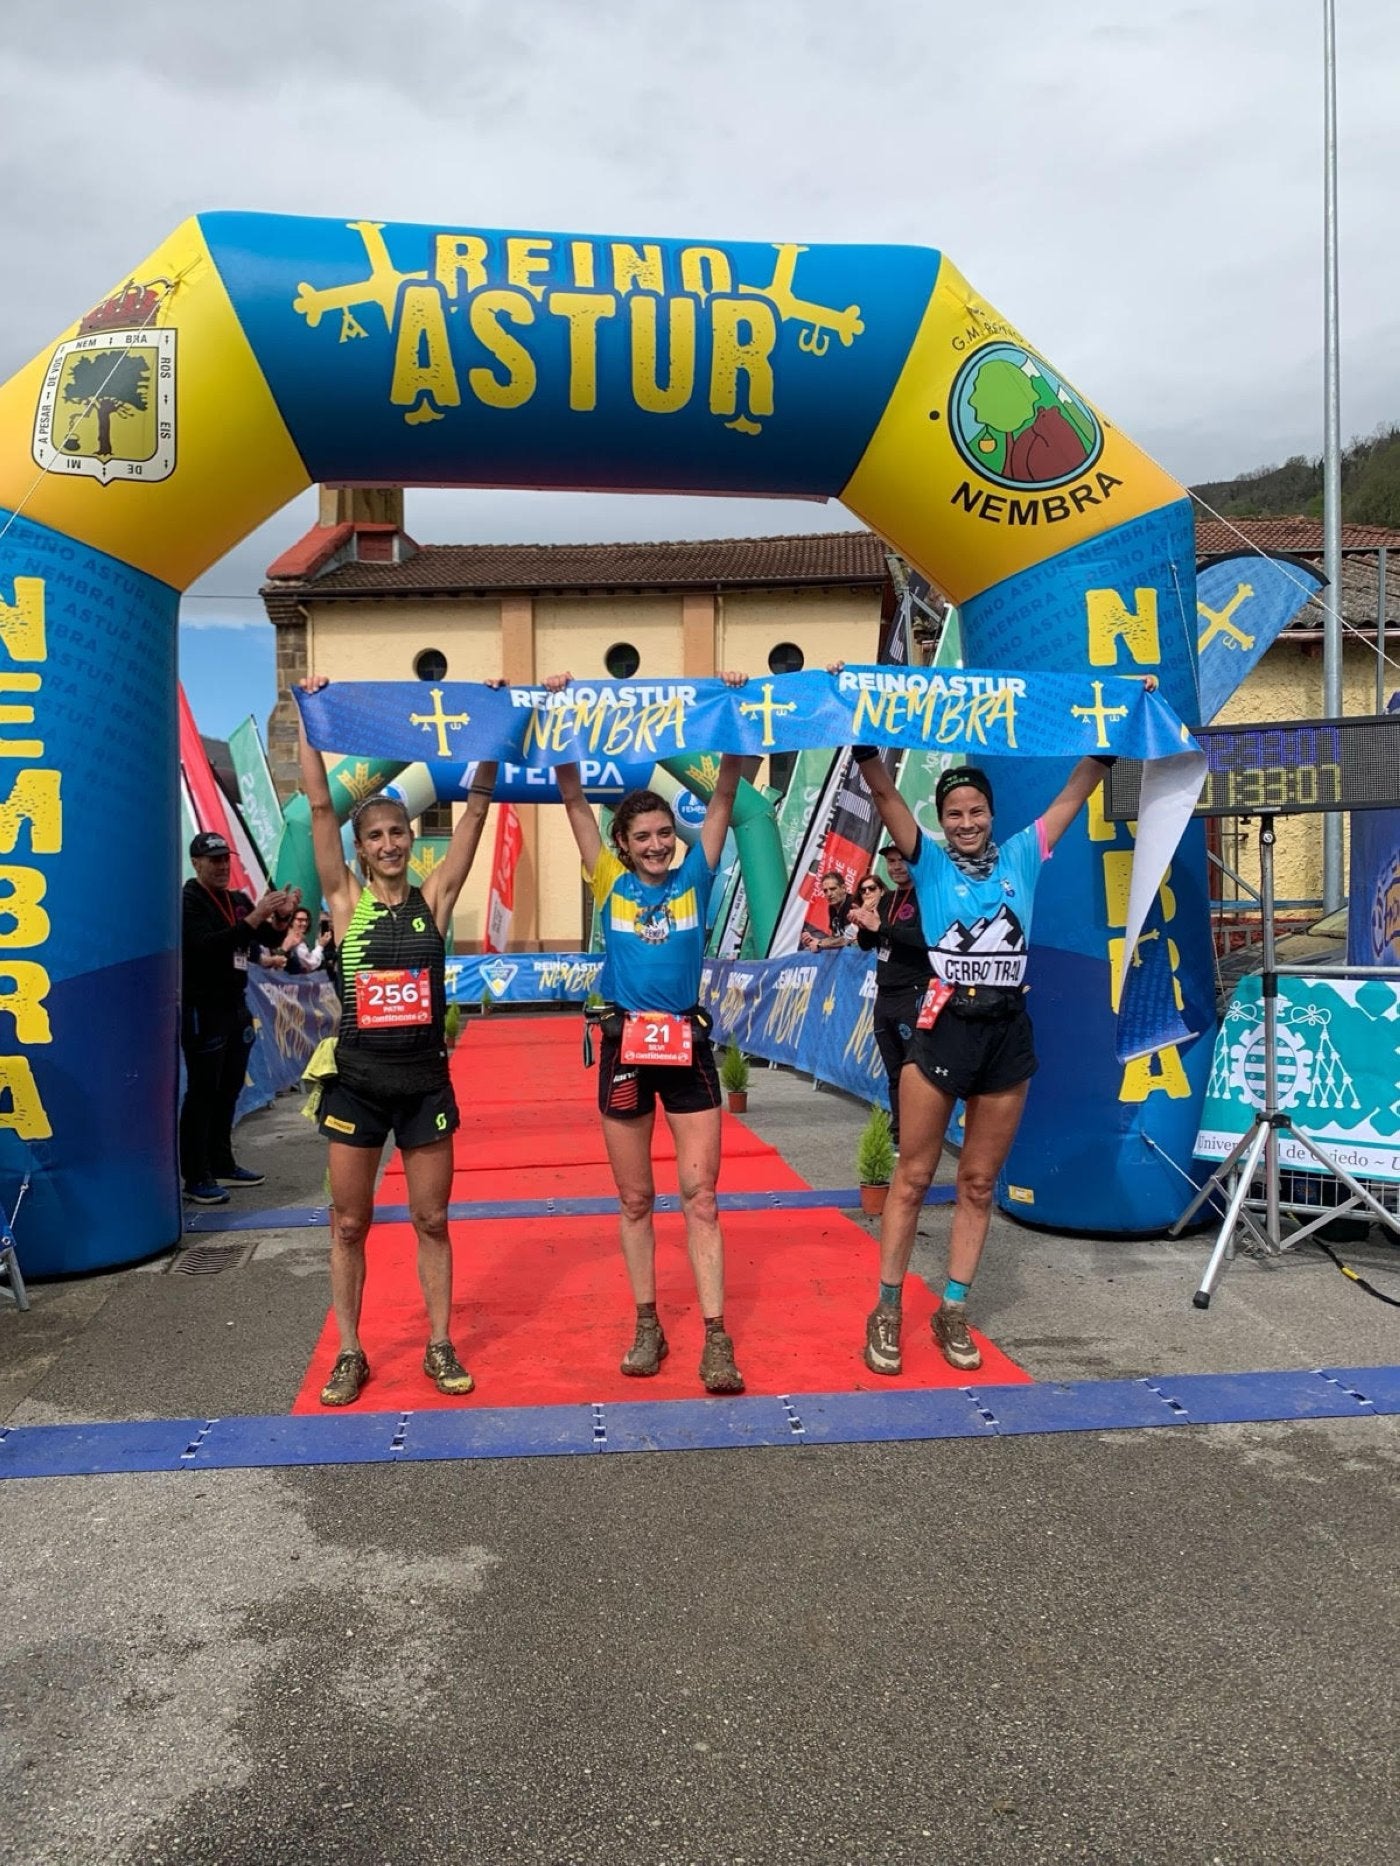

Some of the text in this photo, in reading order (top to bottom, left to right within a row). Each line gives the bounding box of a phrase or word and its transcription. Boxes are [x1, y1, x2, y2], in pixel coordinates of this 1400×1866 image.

[434, 234, 733, 306] REINO
[76, 338, 97, 349] NEM
[390, 286, 776, 417] ASTUR
[160, 357, 171, 379] ROS
[39, 405, 52, 435] PESAR
[160, 421, 171, 440] EIS
[951, 472, 1123, 526] NEMBRA
[511, 685, 697, 710] REINOASTUR
[838, 671, 1027, 699] REINOASTUR
[522, 698, 688, 760] NEMBRA
[851, 687, 1019, 749] NEMBRA
[504, 760, 625, 786] FEPA
[572, 961, 604, 972] ASTU
[945, 959, 991, 981] CERRO
[368, 983, 418, 1006] 256
[644, 1024, 670, 1044] 21
[1286, 1145, 1306, 1159] de
